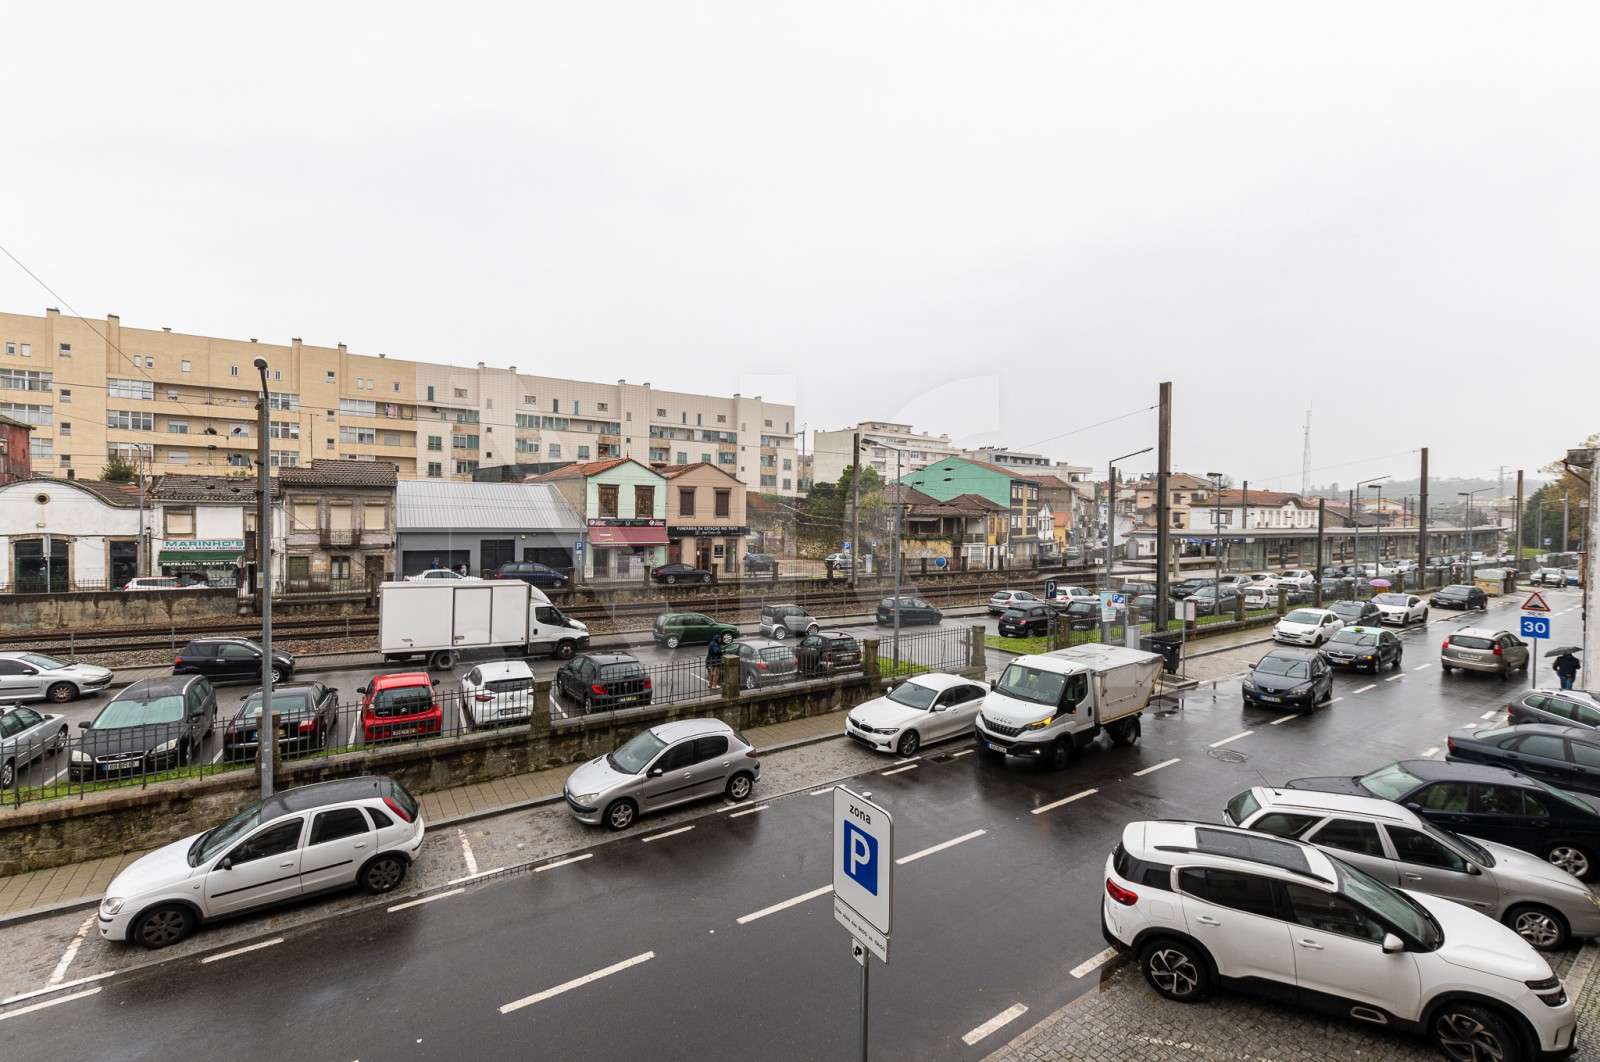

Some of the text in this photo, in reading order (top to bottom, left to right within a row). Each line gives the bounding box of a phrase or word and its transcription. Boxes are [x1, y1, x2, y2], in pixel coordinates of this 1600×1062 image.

[1048, 582, 1055, 596] P
[1523, 621, 1546, 634] 30
[849, 804, 871, 825] zona
[850, 828, 871, 876] P
